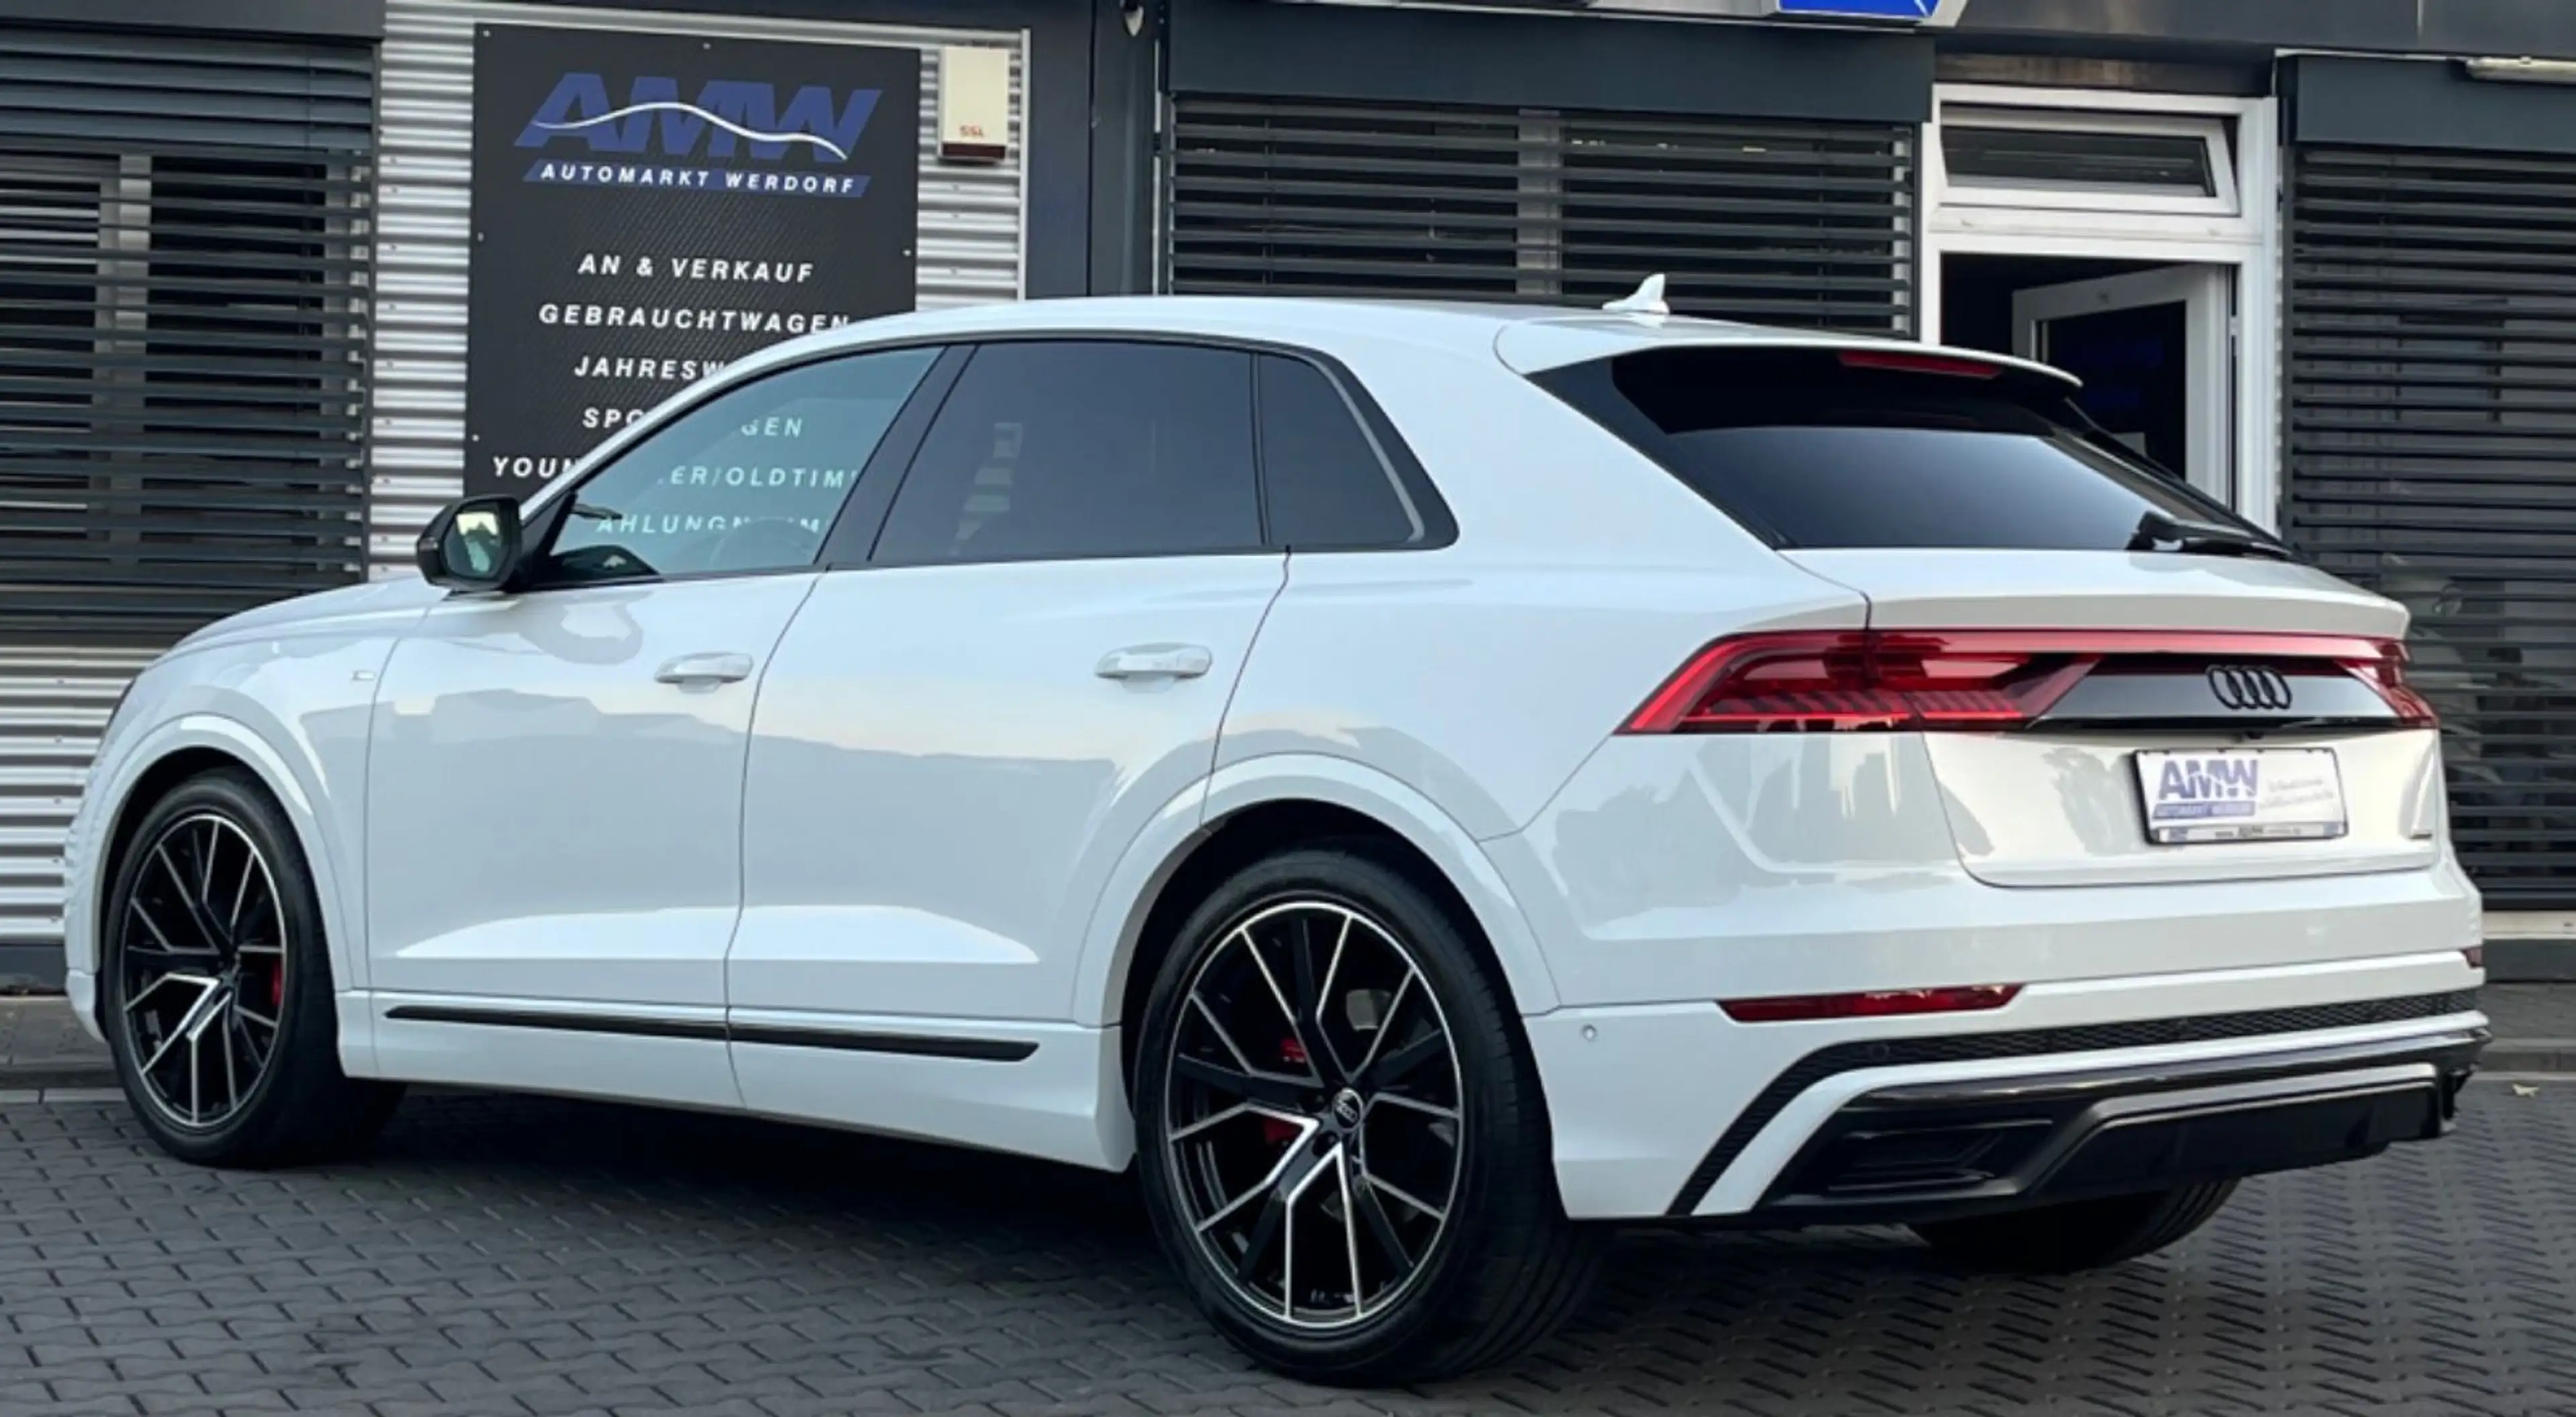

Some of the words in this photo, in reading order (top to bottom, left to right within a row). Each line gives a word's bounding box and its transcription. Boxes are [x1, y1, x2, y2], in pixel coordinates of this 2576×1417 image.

[514, 73, 883, 163] AMW
[541, 163, 710, 187] AUTOMARKT
[725, 172, 855, 194] WERDORF
[577, 253, 621, 275] AN
[636, 256, 653, 277] &
[672, 257, 814, 283] VERKAUF
[539, 303, 849, 333] GEBRAUCHTWAGEN
[574, 355, 724, 380] JAHRESW
[2159, 759, 2259, 800] AMW
